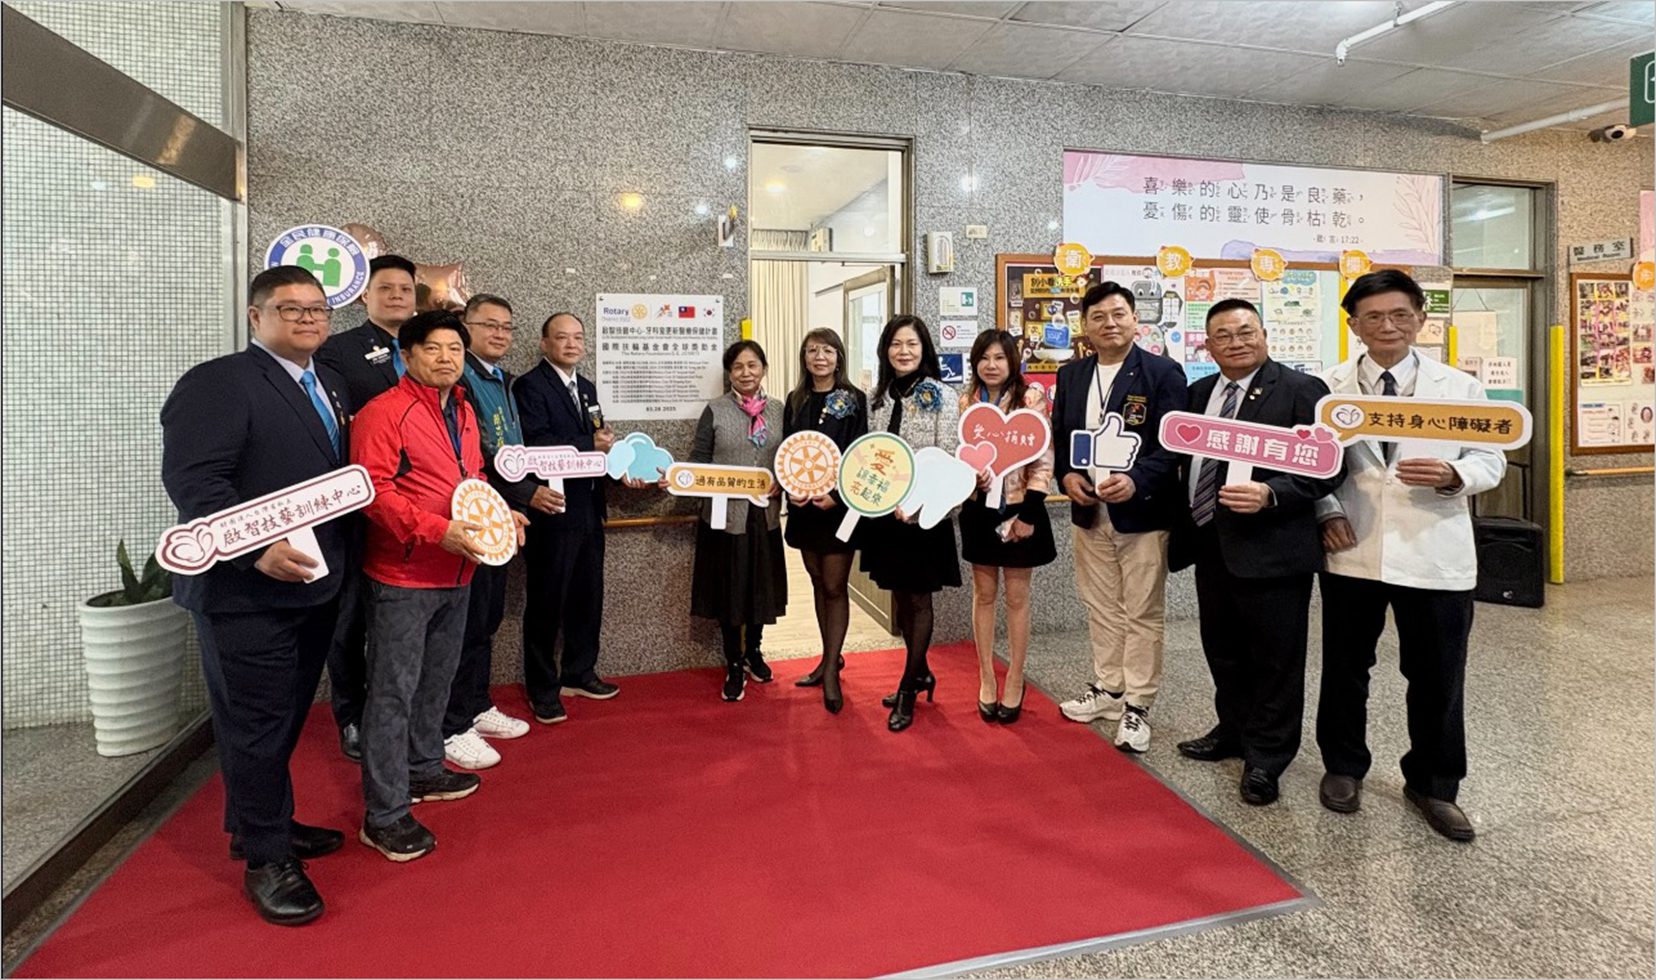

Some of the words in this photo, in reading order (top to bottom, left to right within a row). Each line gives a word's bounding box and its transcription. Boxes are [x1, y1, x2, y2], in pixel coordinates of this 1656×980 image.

[603, 307, 629, 316] Rotary
[1368, 412, 1513, 435] 支持身心障礙者
[1206, 429, 1319, 466] 感謝有您
[870, 449, 895, 475] 愛
[695, 475, 766, 490] 過有品質的生活
